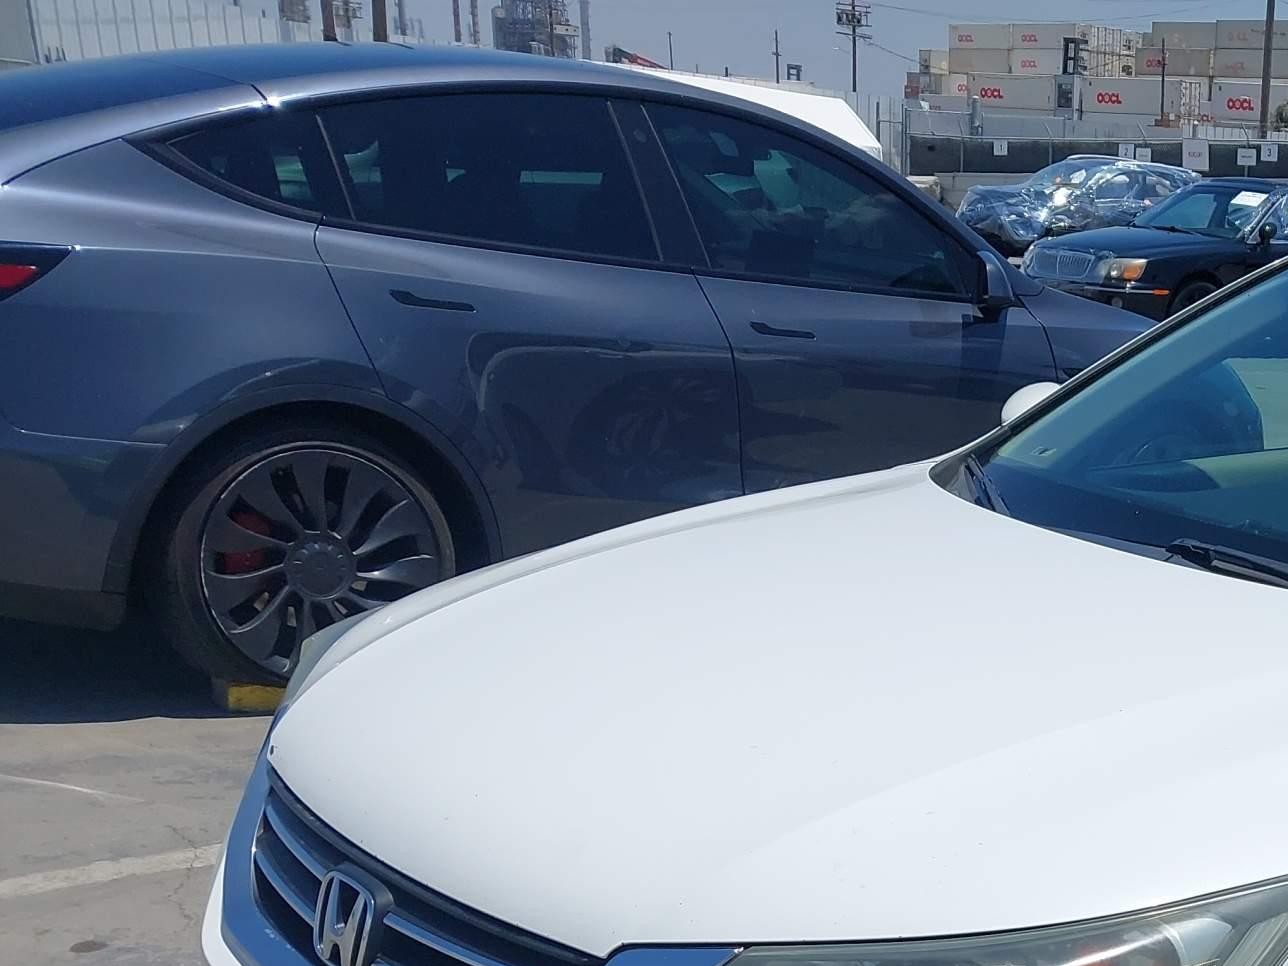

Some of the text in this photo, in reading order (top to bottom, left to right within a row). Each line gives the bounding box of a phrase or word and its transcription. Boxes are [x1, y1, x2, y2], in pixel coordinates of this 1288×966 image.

[958, 34, 974, 43] OOCL
[1021, 34, 1038, 43] OOCL
[980, 88, 1004, 99] OOCL
[1096, 92, 1122, 104] OOCL
[1227, 97, 1254, 111] OOCL
[1267, 148, 1272, 157] 3
